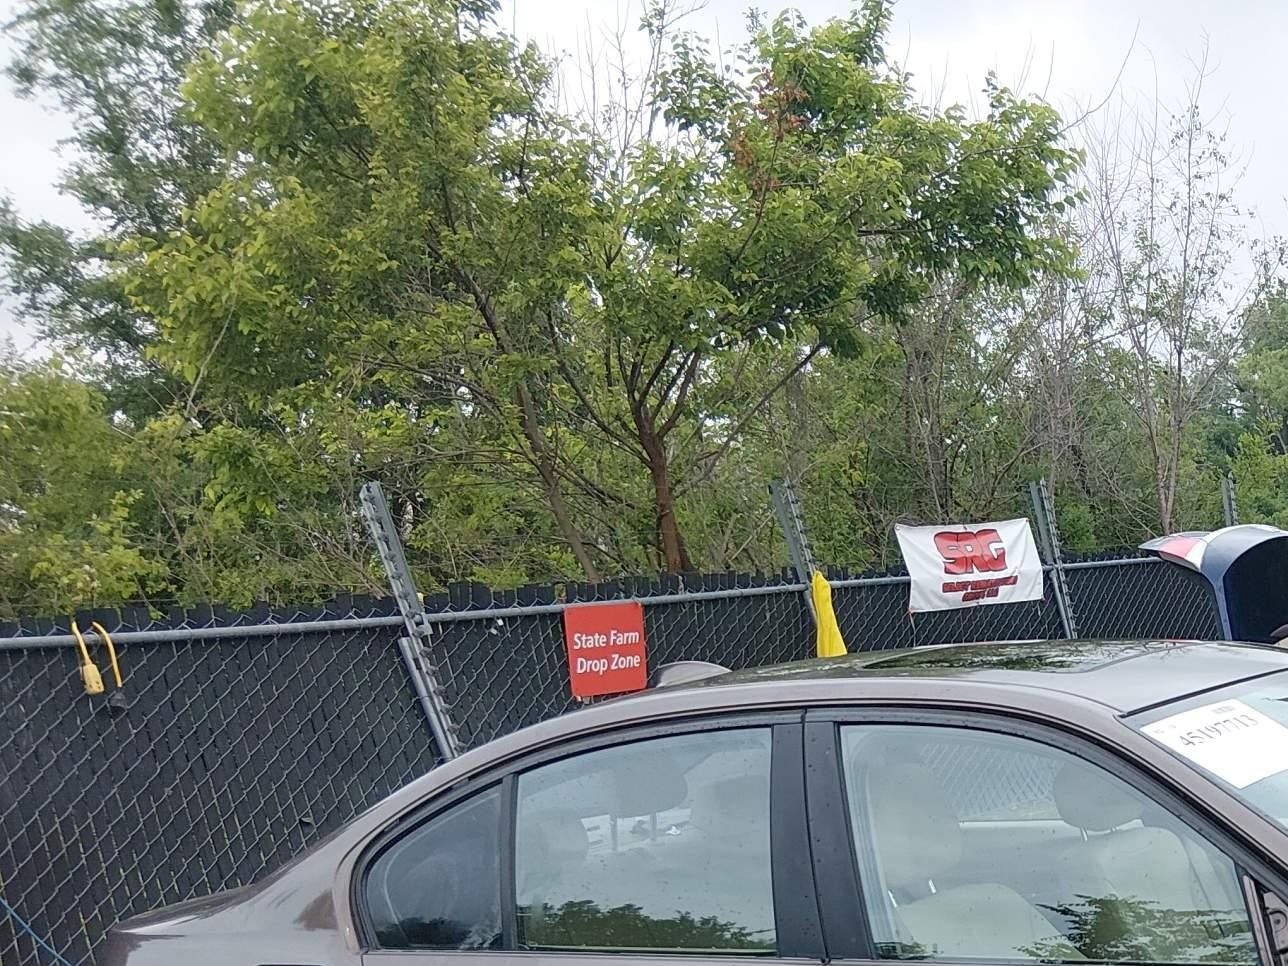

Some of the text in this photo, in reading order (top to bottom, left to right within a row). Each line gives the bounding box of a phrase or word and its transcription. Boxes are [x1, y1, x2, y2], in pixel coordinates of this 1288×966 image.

[573, 629, 640, 650] State Farm
[576, 653, 641, 676] Drop Zone
[1179, 714, 1259, 746] 45197713
